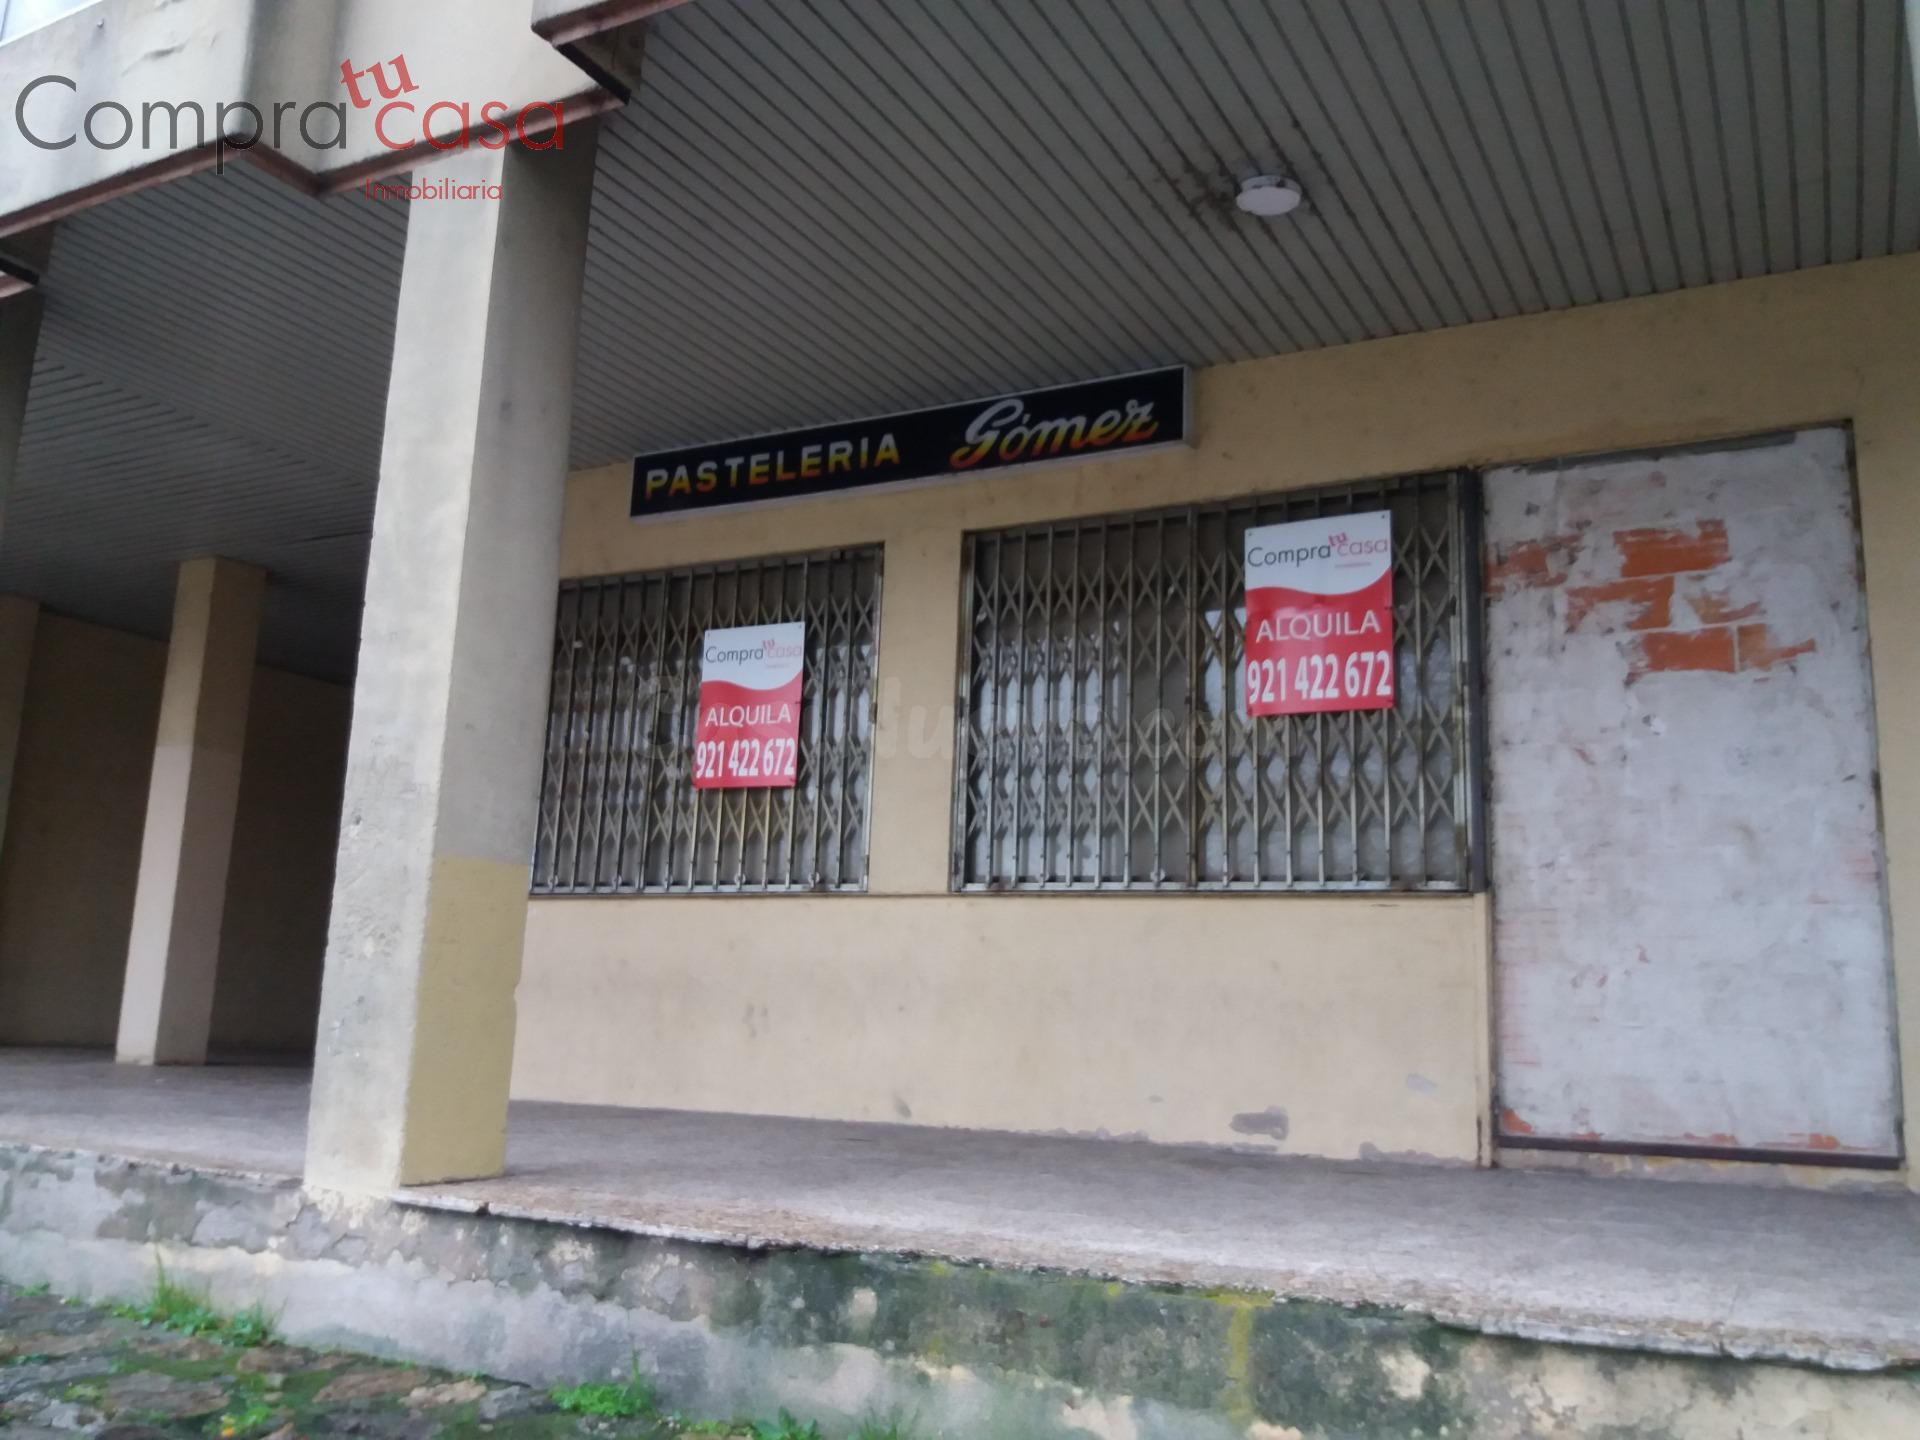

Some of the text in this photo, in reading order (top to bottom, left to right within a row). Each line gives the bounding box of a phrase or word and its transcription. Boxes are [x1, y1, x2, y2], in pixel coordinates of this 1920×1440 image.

[645, 433, 900, 499] PASTELERIA
[1247, 545, 1330, 567] Compra
[1337, 540, 1388, 556] casa
[1256, 609, 1381, 643] ALQUILA
[705, 646, 763, 665] Compra
[1247, 650, 1391, 704] 921 422 672
[705, 703, 791, 728] ALQUILA
[696, 737, 795, 778] 921 422 672
